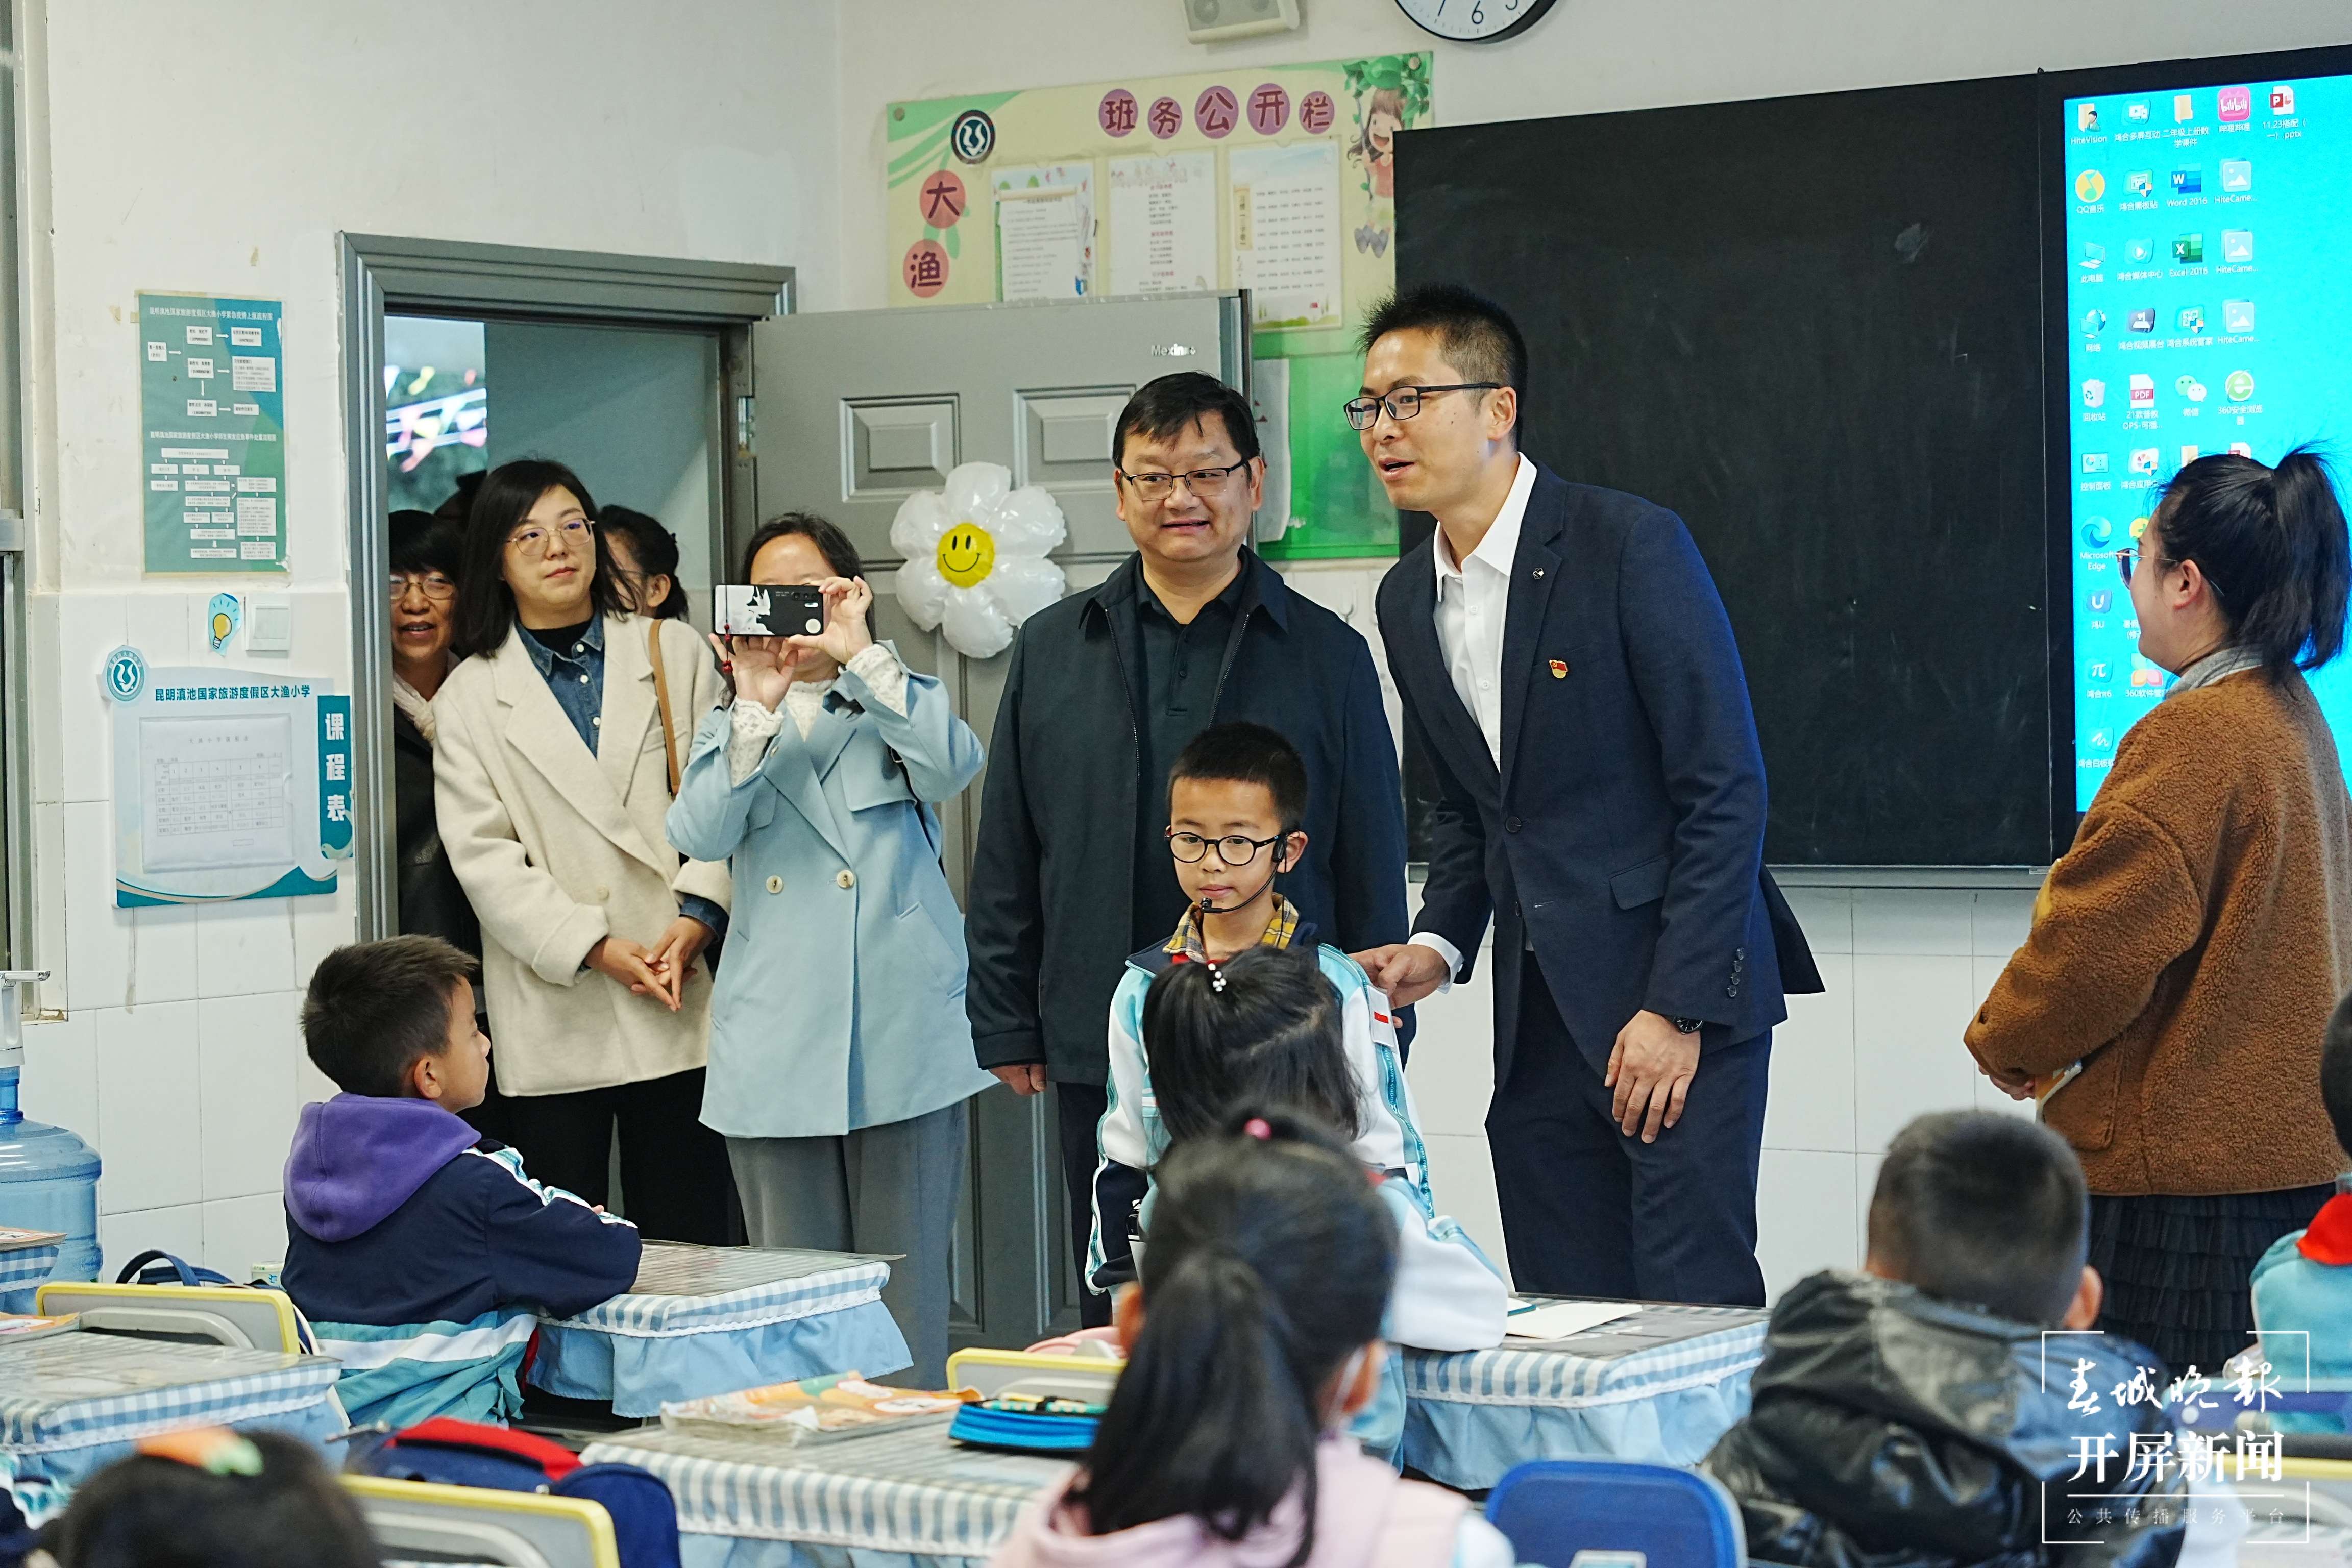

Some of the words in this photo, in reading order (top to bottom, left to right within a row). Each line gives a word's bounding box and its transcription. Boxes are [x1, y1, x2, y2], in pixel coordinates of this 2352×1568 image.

[2220, 97, 2247, 113] bilibili
[1105, 89, 1330, 136] 班务公开栏
[2218, 122, 2250, 133] 哔哩哔哩
[2070, 135, 2108, 145] HiteVision
[2166, 198, 2187, 207] Word
[2188, 196, 2208, 205] 2016
[2076, 204, 2104, 214] QQ音乐
[911, 181, 962, 289] 大渔
[2169, 268, 2188, 277] Excel
[2189, 267, 2208, 276] 2016
[2135, 391, 2150, 400] PDF
[2080, 551, 2115, 560] Microsoft
[2088, 562, 2106, 571] Edge
[155, 684, 311, 702] 昆明滇池国家旅游度假区大渔小学
[325, 713, 348, 822] 课程表
